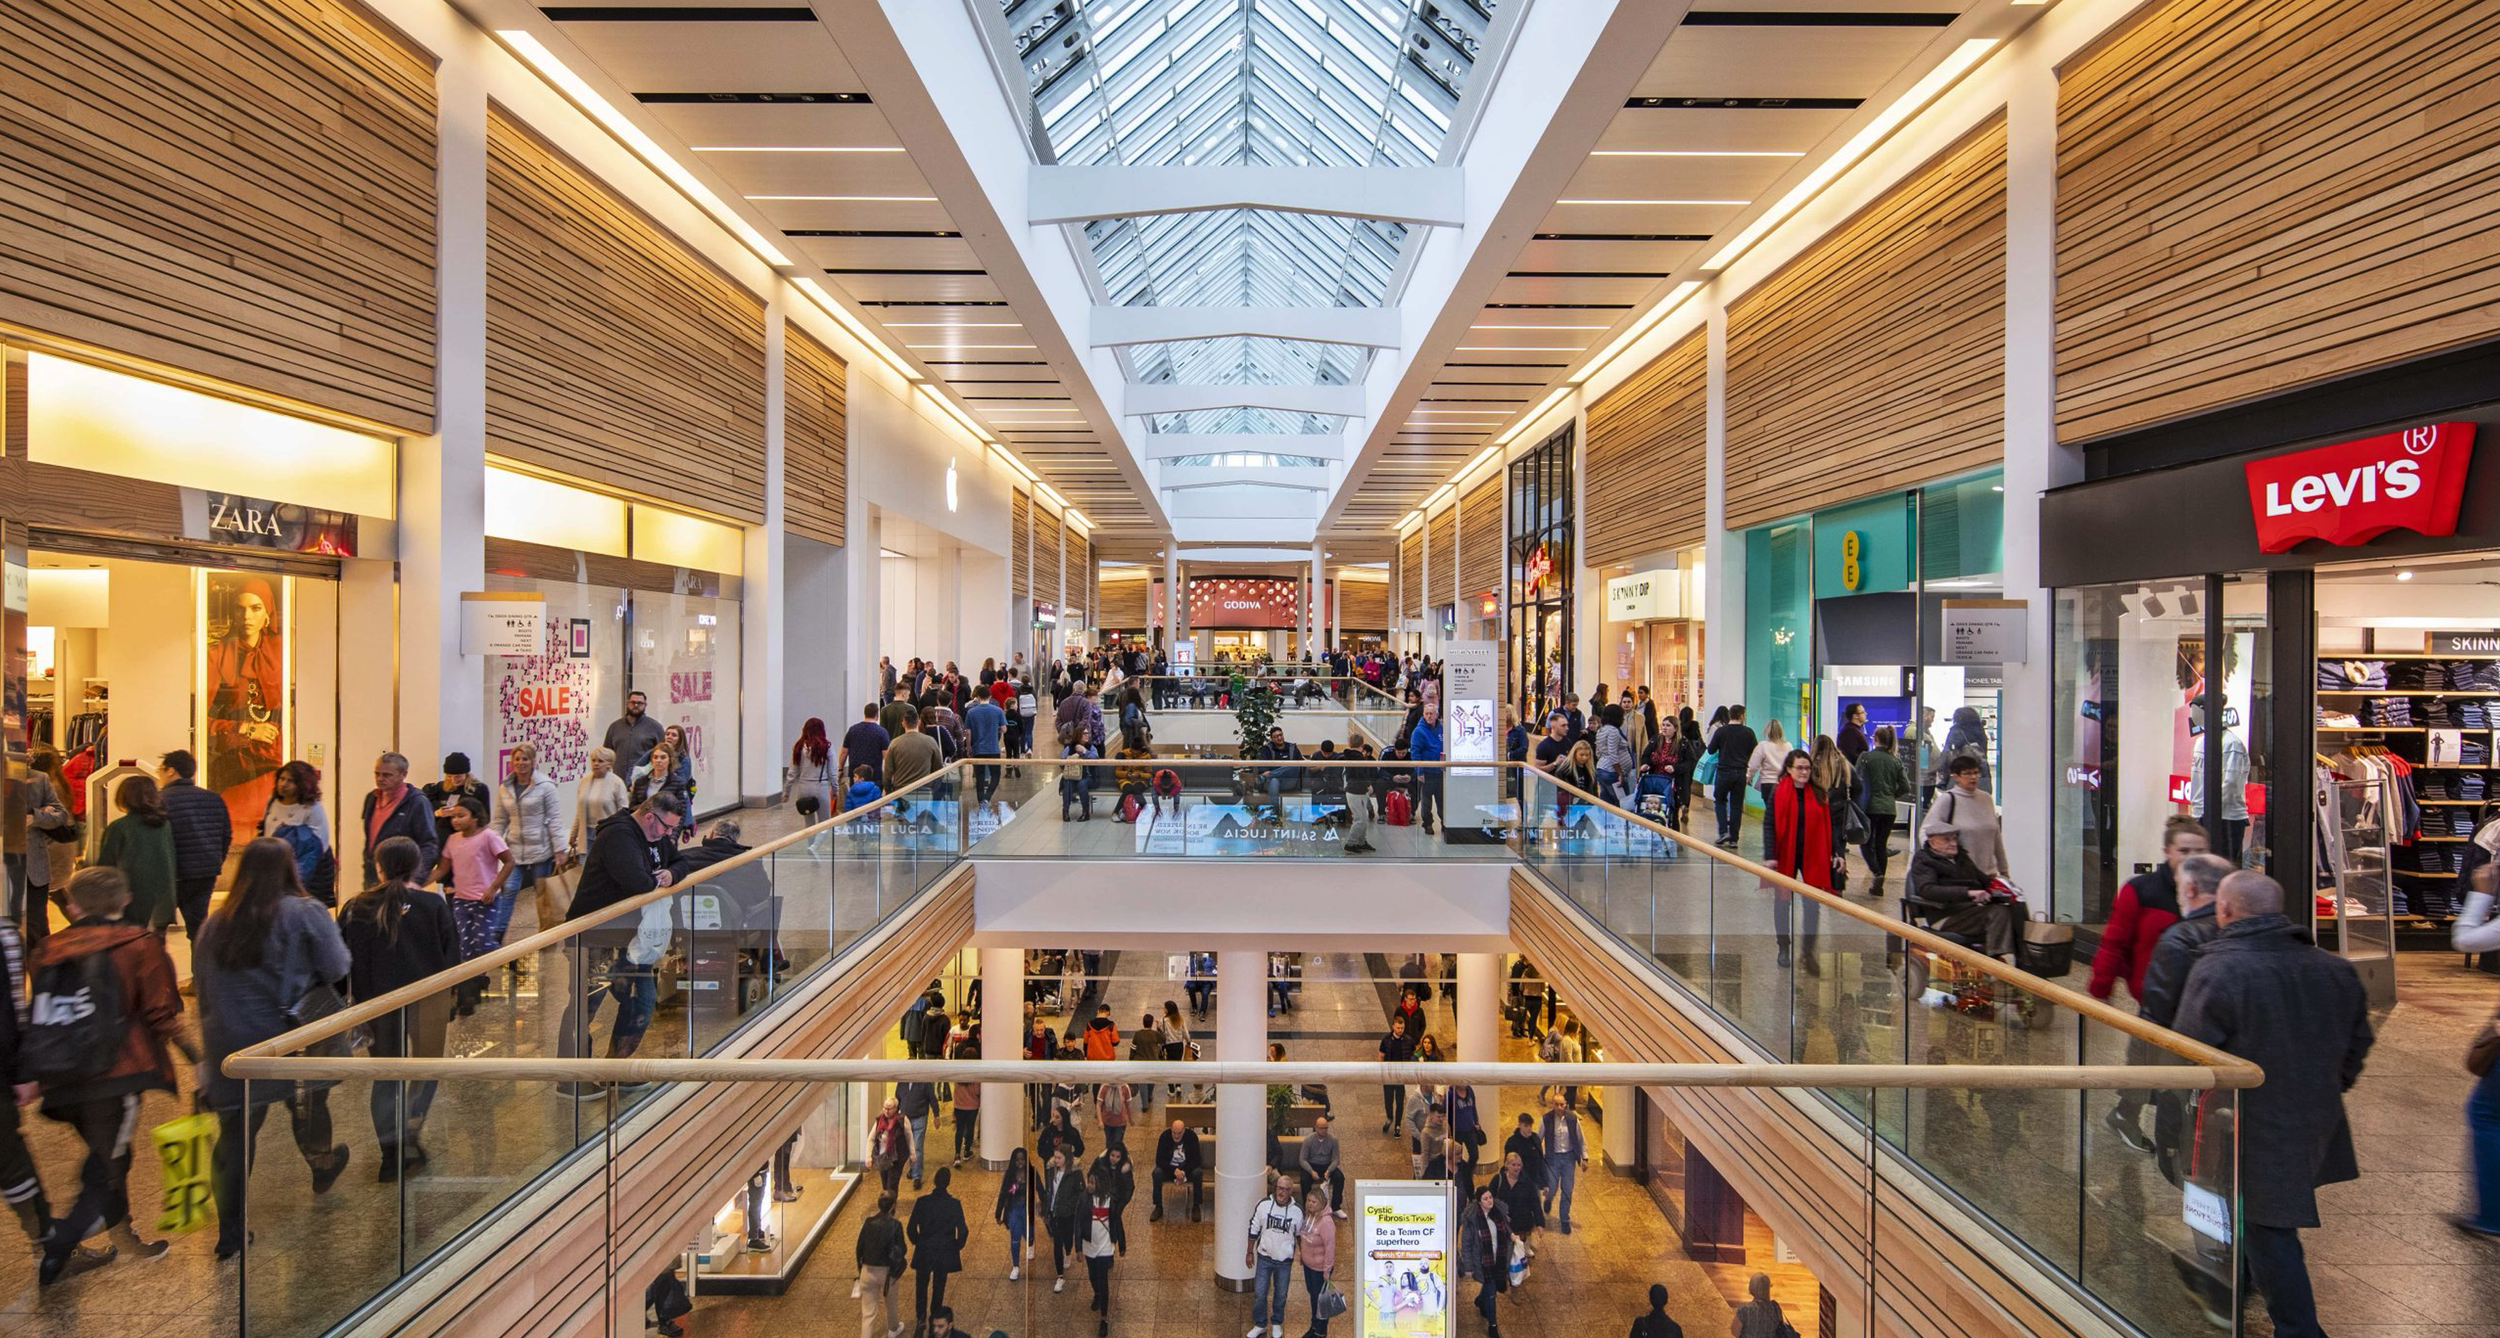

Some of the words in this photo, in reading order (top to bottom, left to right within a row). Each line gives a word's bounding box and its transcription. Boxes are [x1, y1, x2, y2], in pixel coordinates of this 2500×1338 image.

[211, 504, 282, 537] ZARA
[1223, 600, 1261, 609] GODIVA
[1838, 676, 1897, 686] SAMSUNG
[671, 671, 712, 704] SALE
[519, 686, 570, 717] SALE
[1552, 829, 1591, 840] LUCIA
[1367, 1206, 1393, 1215] Cystic
[1378, 1214, 1410, 1222] Fibrosis
[1412, 1214, 1435, 1222] Trust
[1376, 1228, 1388, 1236] Be
[1398, 1228, 1420, 1236] Team
[1422, 1228, 1435, 1236] CF
[1376, 1238, 1420, 1247] superhero
